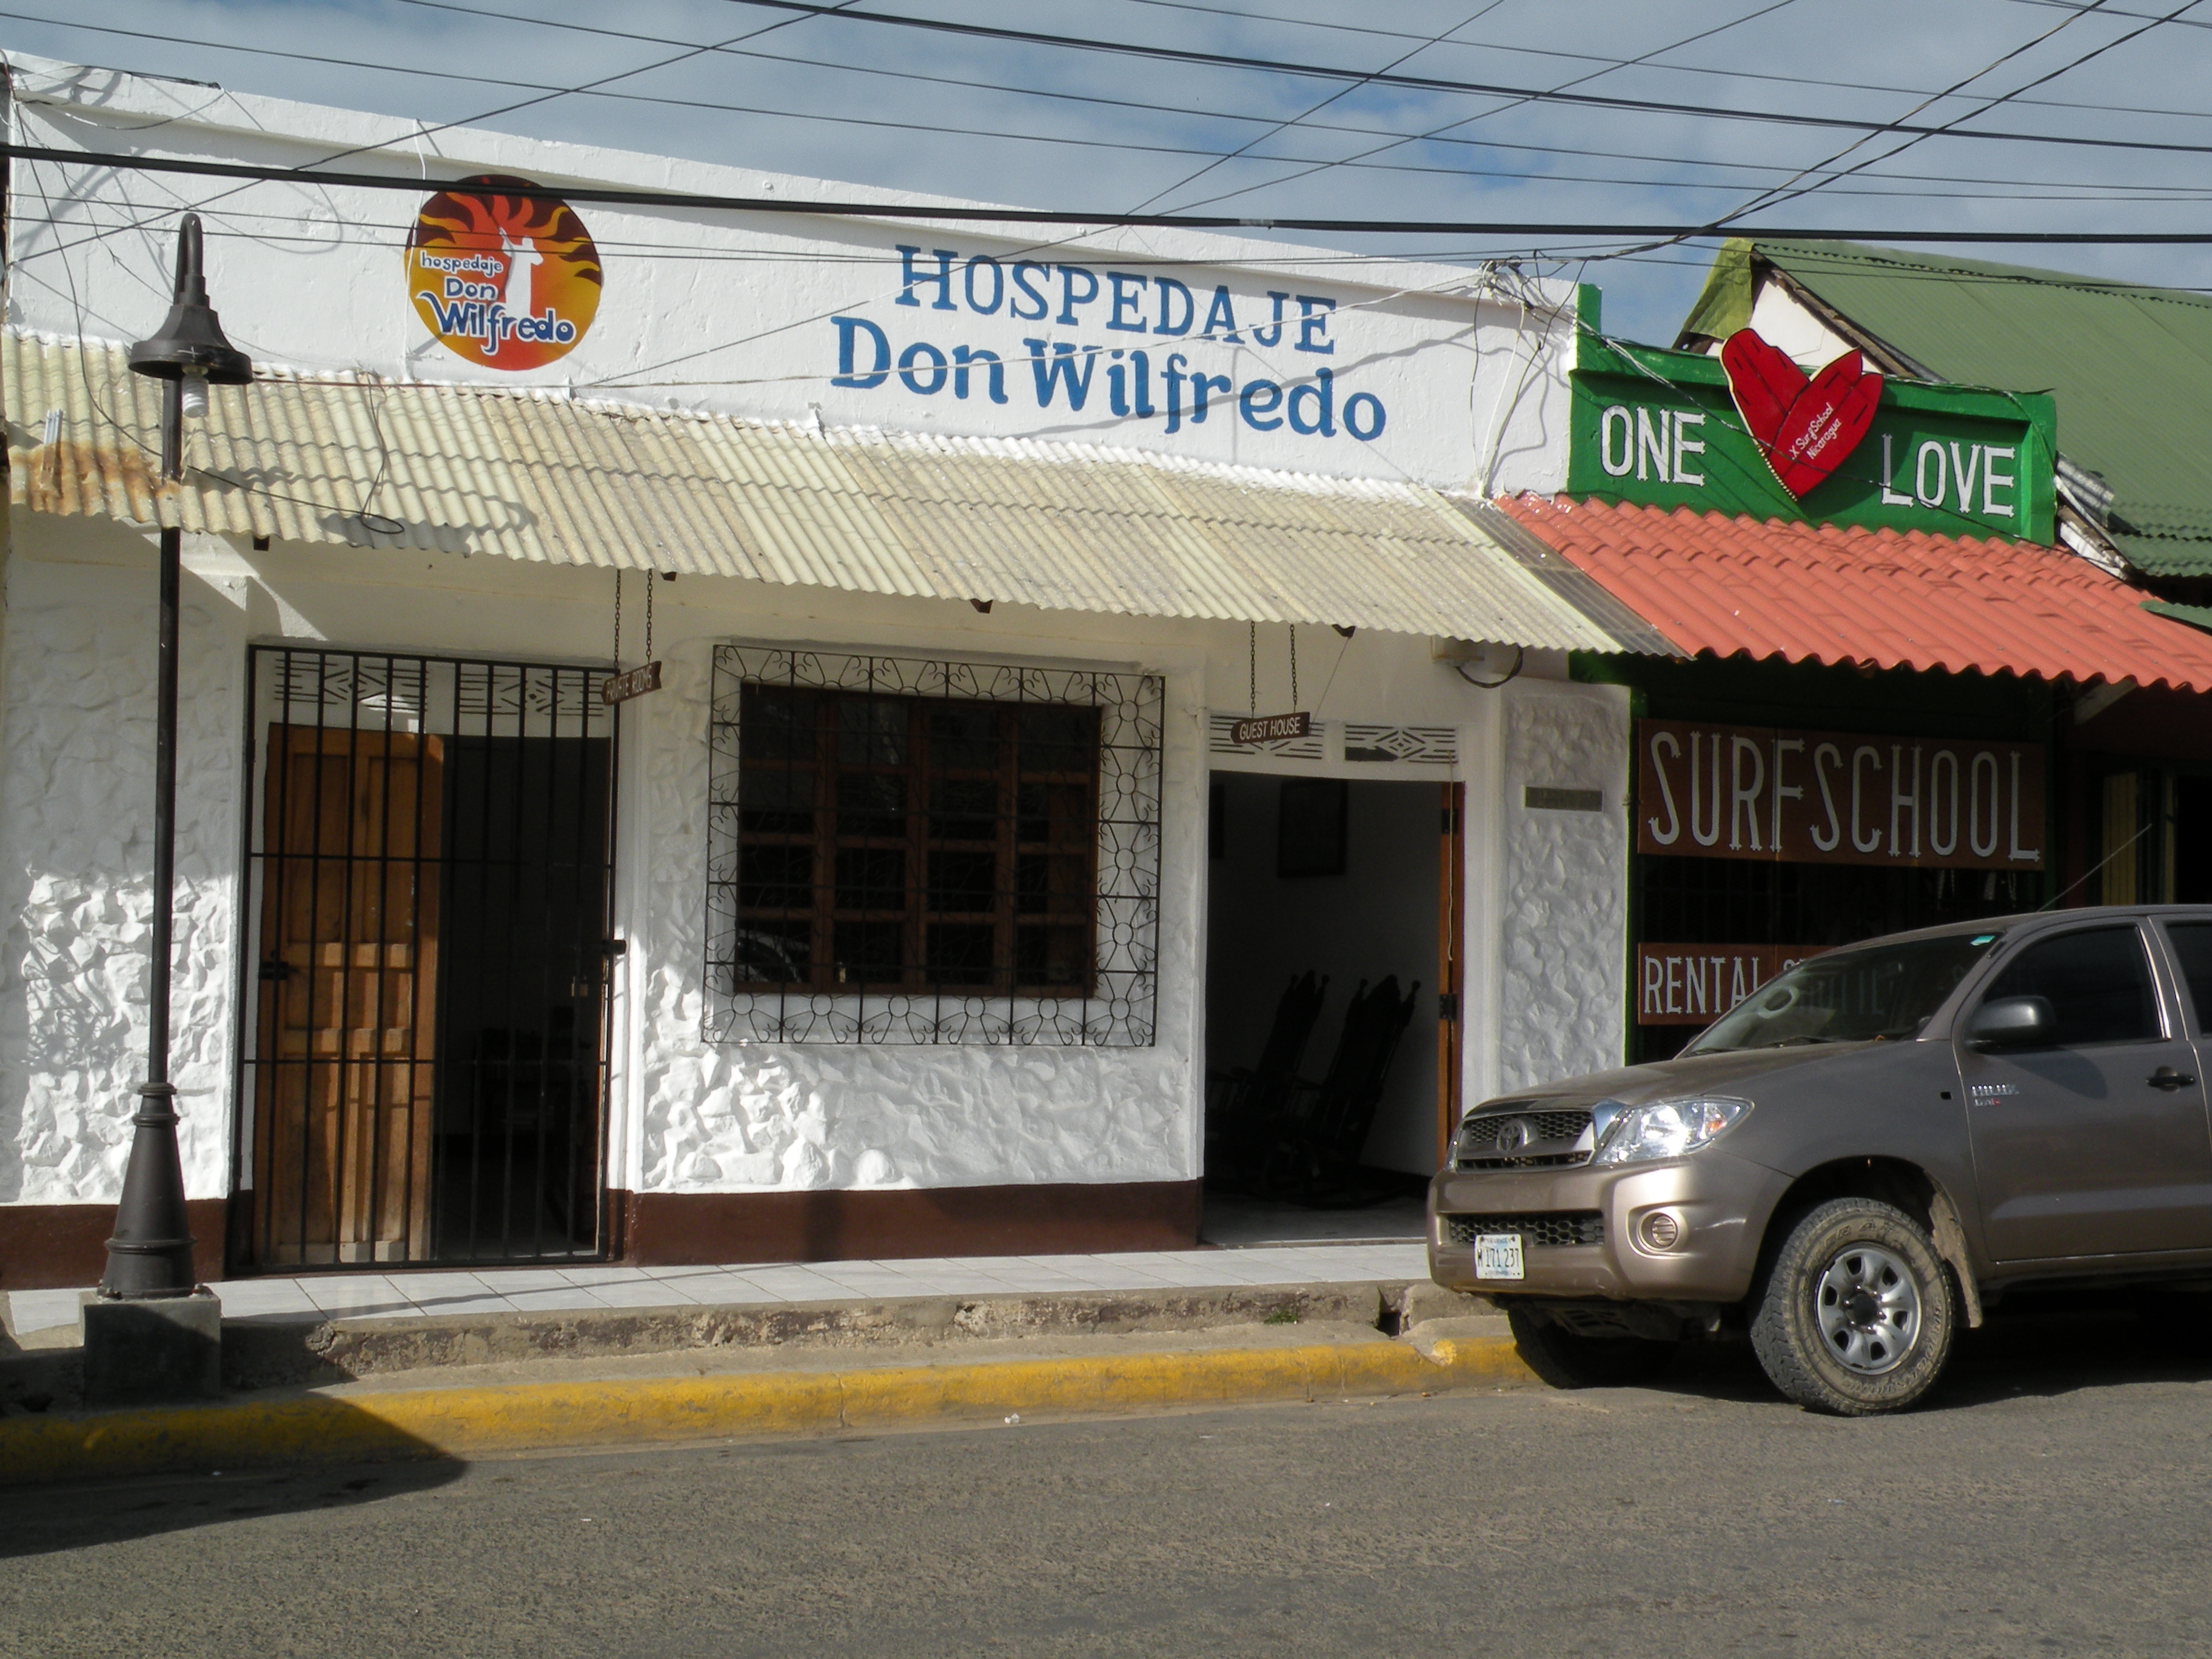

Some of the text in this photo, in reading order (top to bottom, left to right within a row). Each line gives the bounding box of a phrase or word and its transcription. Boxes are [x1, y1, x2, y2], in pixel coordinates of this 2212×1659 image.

[420, 252, 504, 277] hospedaje
[445, 277, 498, 301] Don
[894, 244, 1338, 355] HOSPEDAJE
[417, 292, 575, 354] Wilfredo
[830, 317, 1387, 441] Don Wilfredo
[1806, 418, 1842, 460] Nicaragua
[1601, 405, 2015, 518] ONE LOVE
[1240, 717, 1301, 740] GUEST HOUSE
[1504, 1248, 1519, 1267] 237
